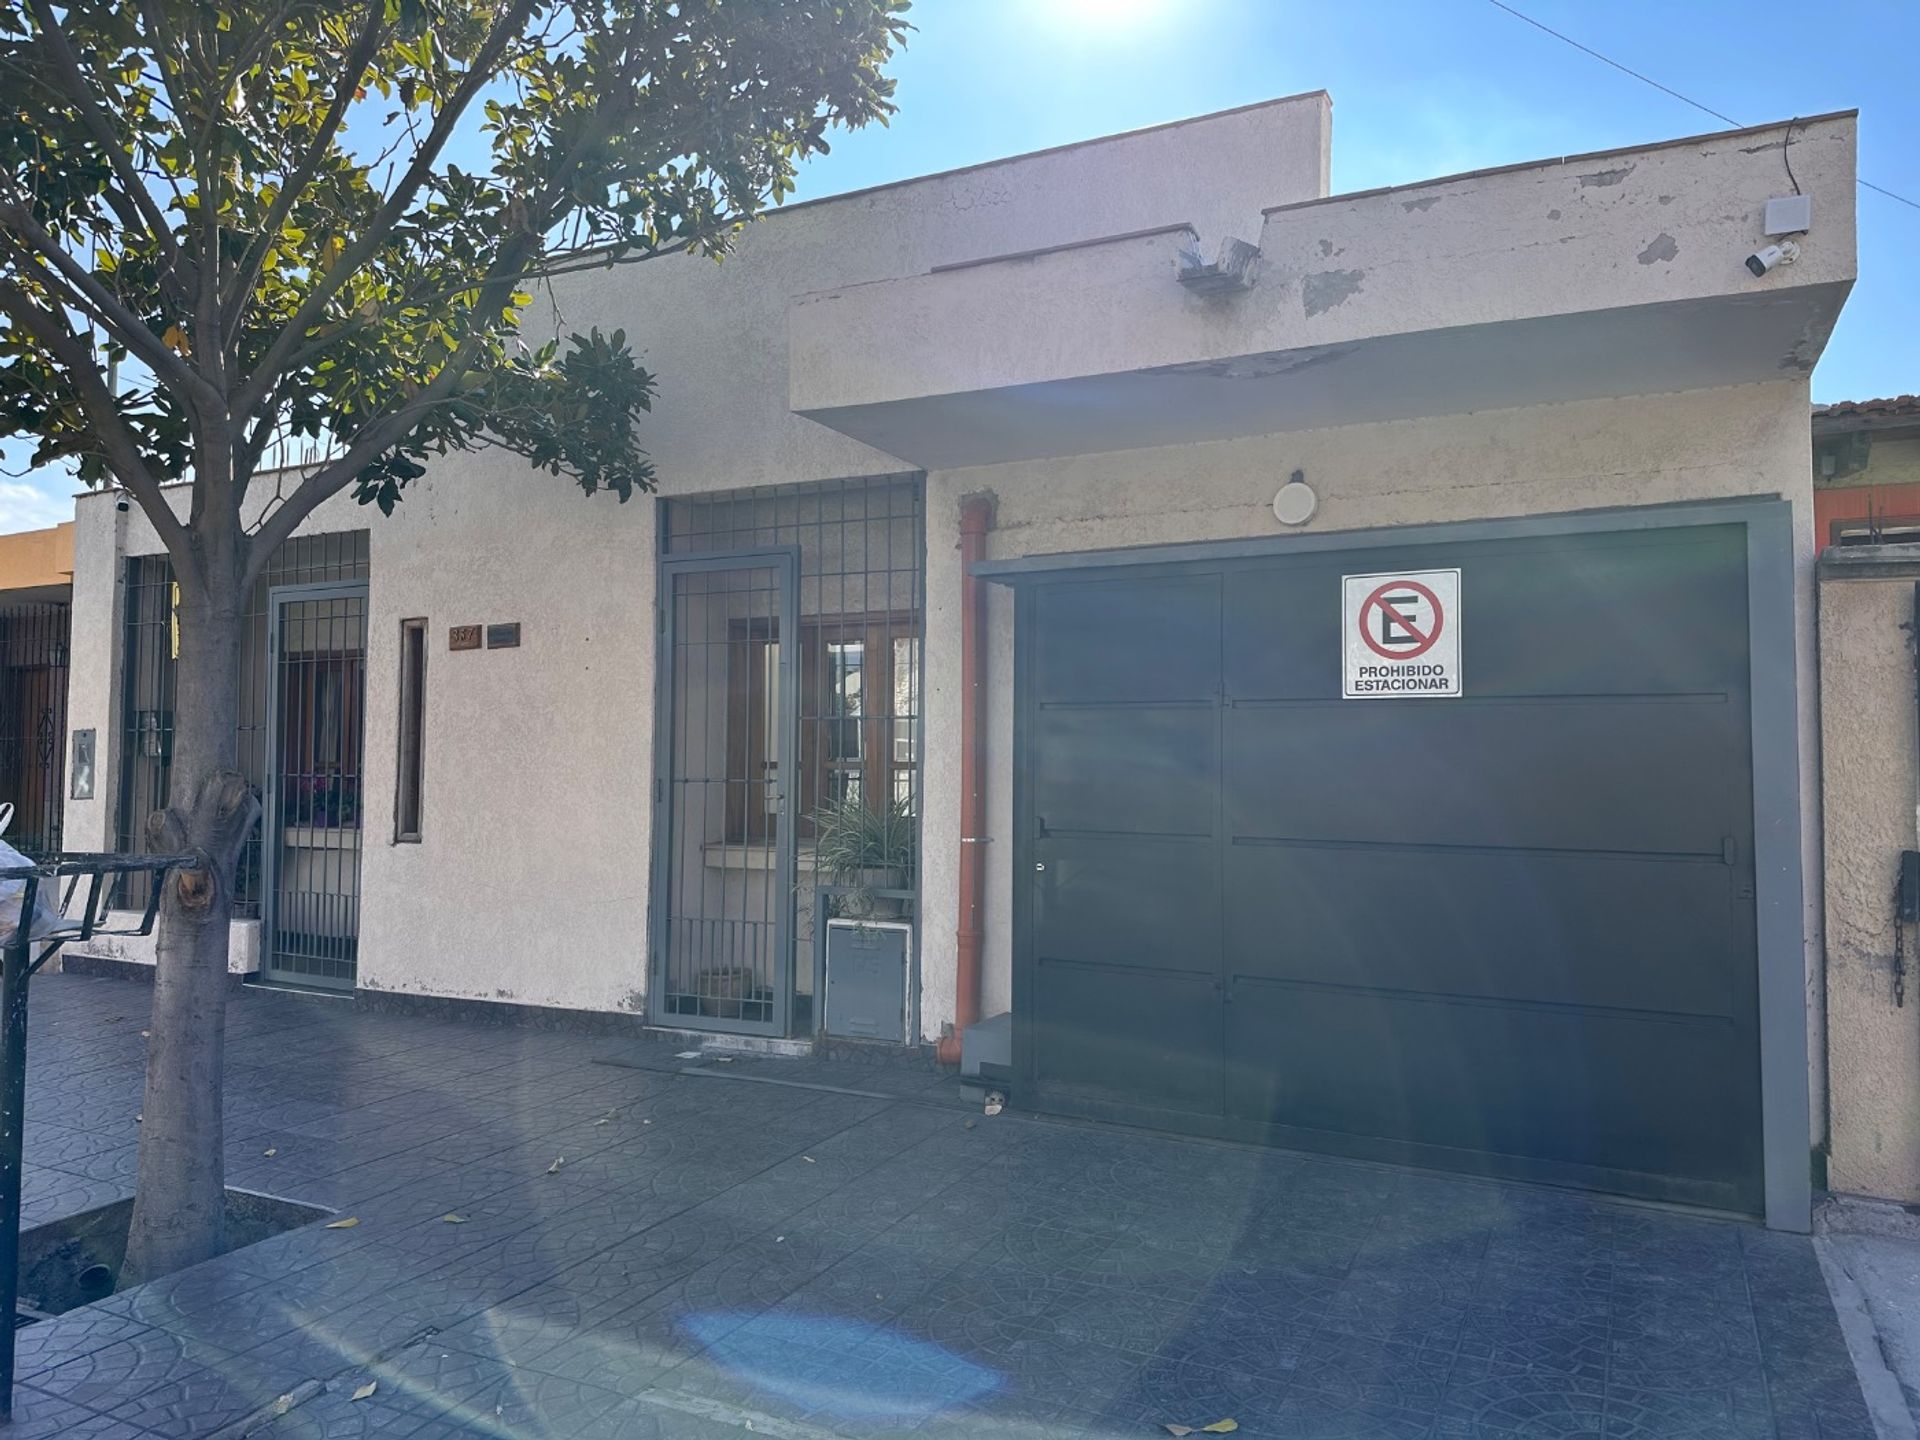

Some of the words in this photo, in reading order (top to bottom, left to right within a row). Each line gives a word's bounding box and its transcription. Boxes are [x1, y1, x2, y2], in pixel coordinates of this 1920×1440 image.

[1382, 596, 1420, 644] E
[1359, 664, 1444, 677] PROHIBIDO
[1355, 678, 1449, 691] ESTACIONAR
